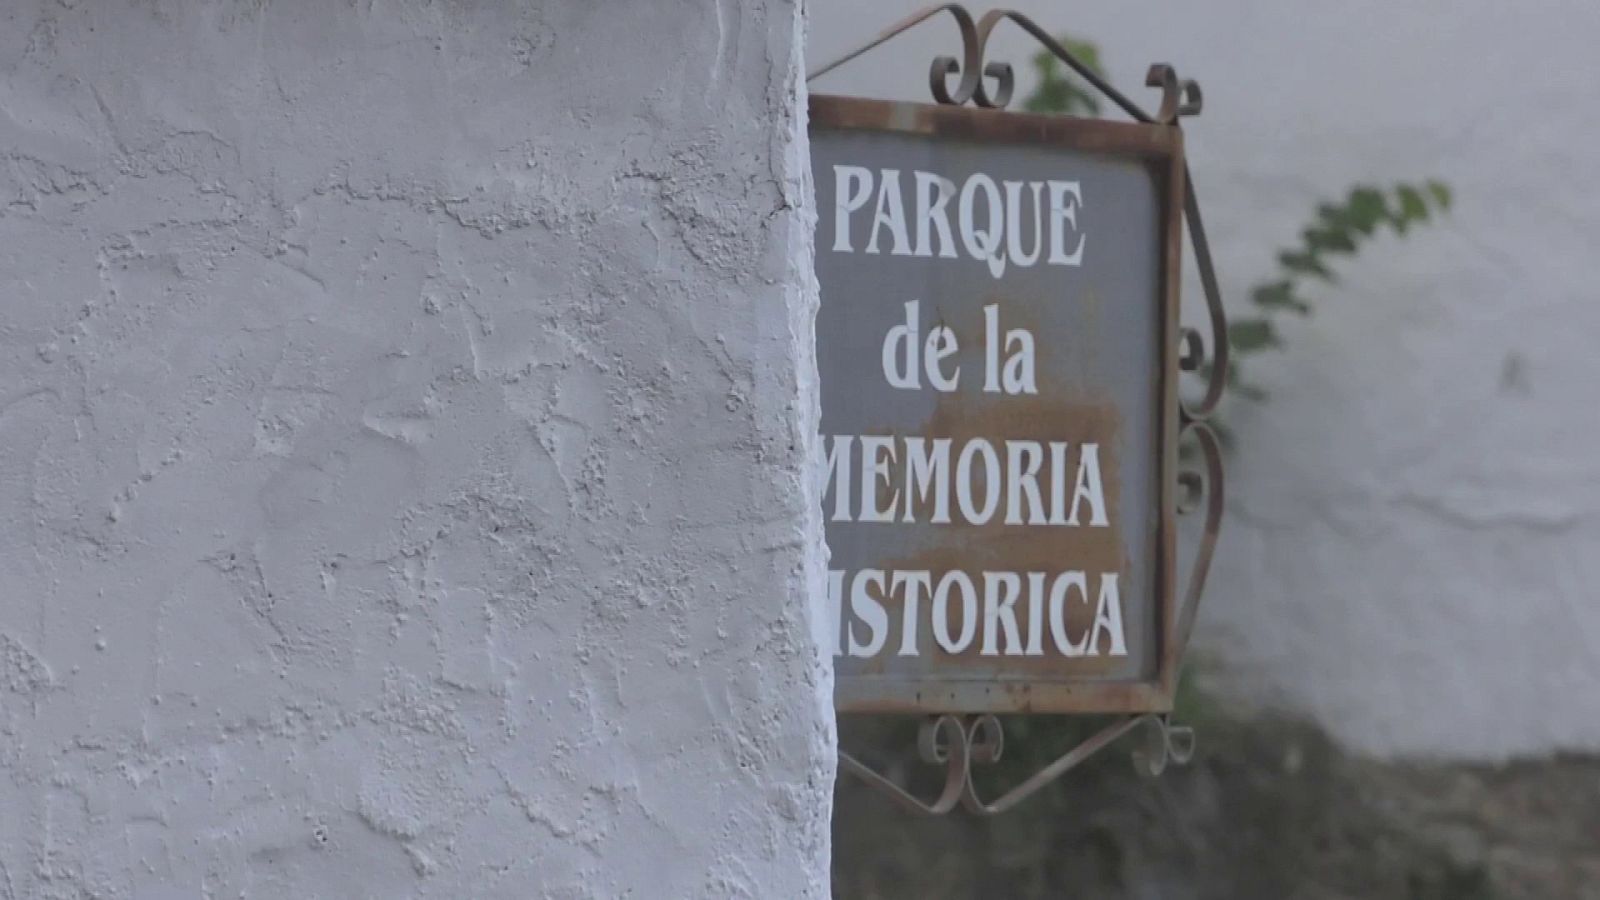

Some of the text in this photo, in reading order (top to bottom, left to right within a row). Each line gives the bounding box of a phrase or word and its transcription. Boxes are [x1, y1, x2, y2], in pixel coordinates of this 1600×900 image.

[832, 164, 1086, 279] PARQUE
[882, 299, 1038, 395] de la
[819, 434, 1109, 527] MEMORIA
[828, 568, 1128, 658] ISTORICA
